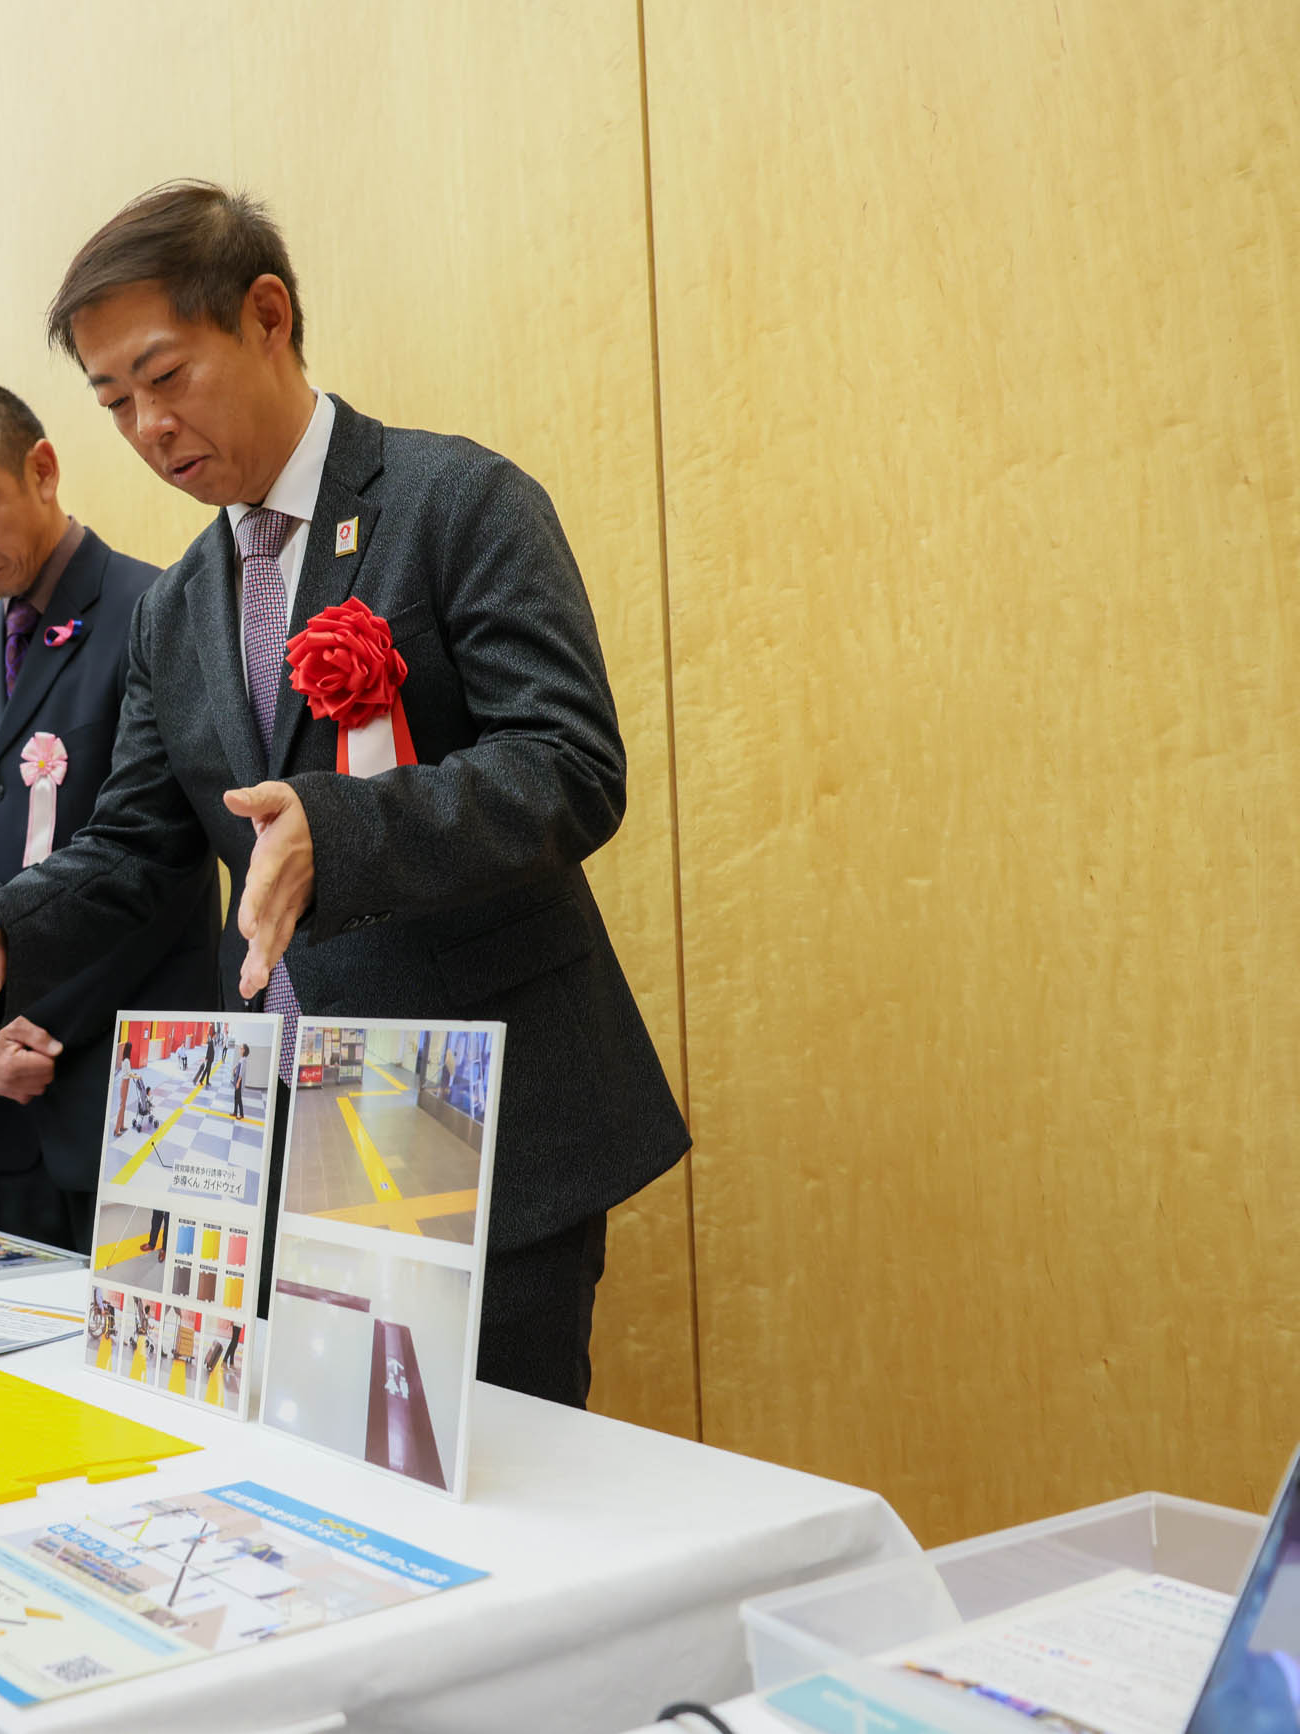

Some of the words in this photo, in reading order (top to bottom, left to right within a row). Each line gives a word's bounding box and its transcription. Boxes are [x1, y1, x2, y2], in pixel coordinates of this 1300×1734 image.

[173, 1174, 200, 1189] 歩導くん
[203, 1178, 243, 1196] ガイドウェイ
